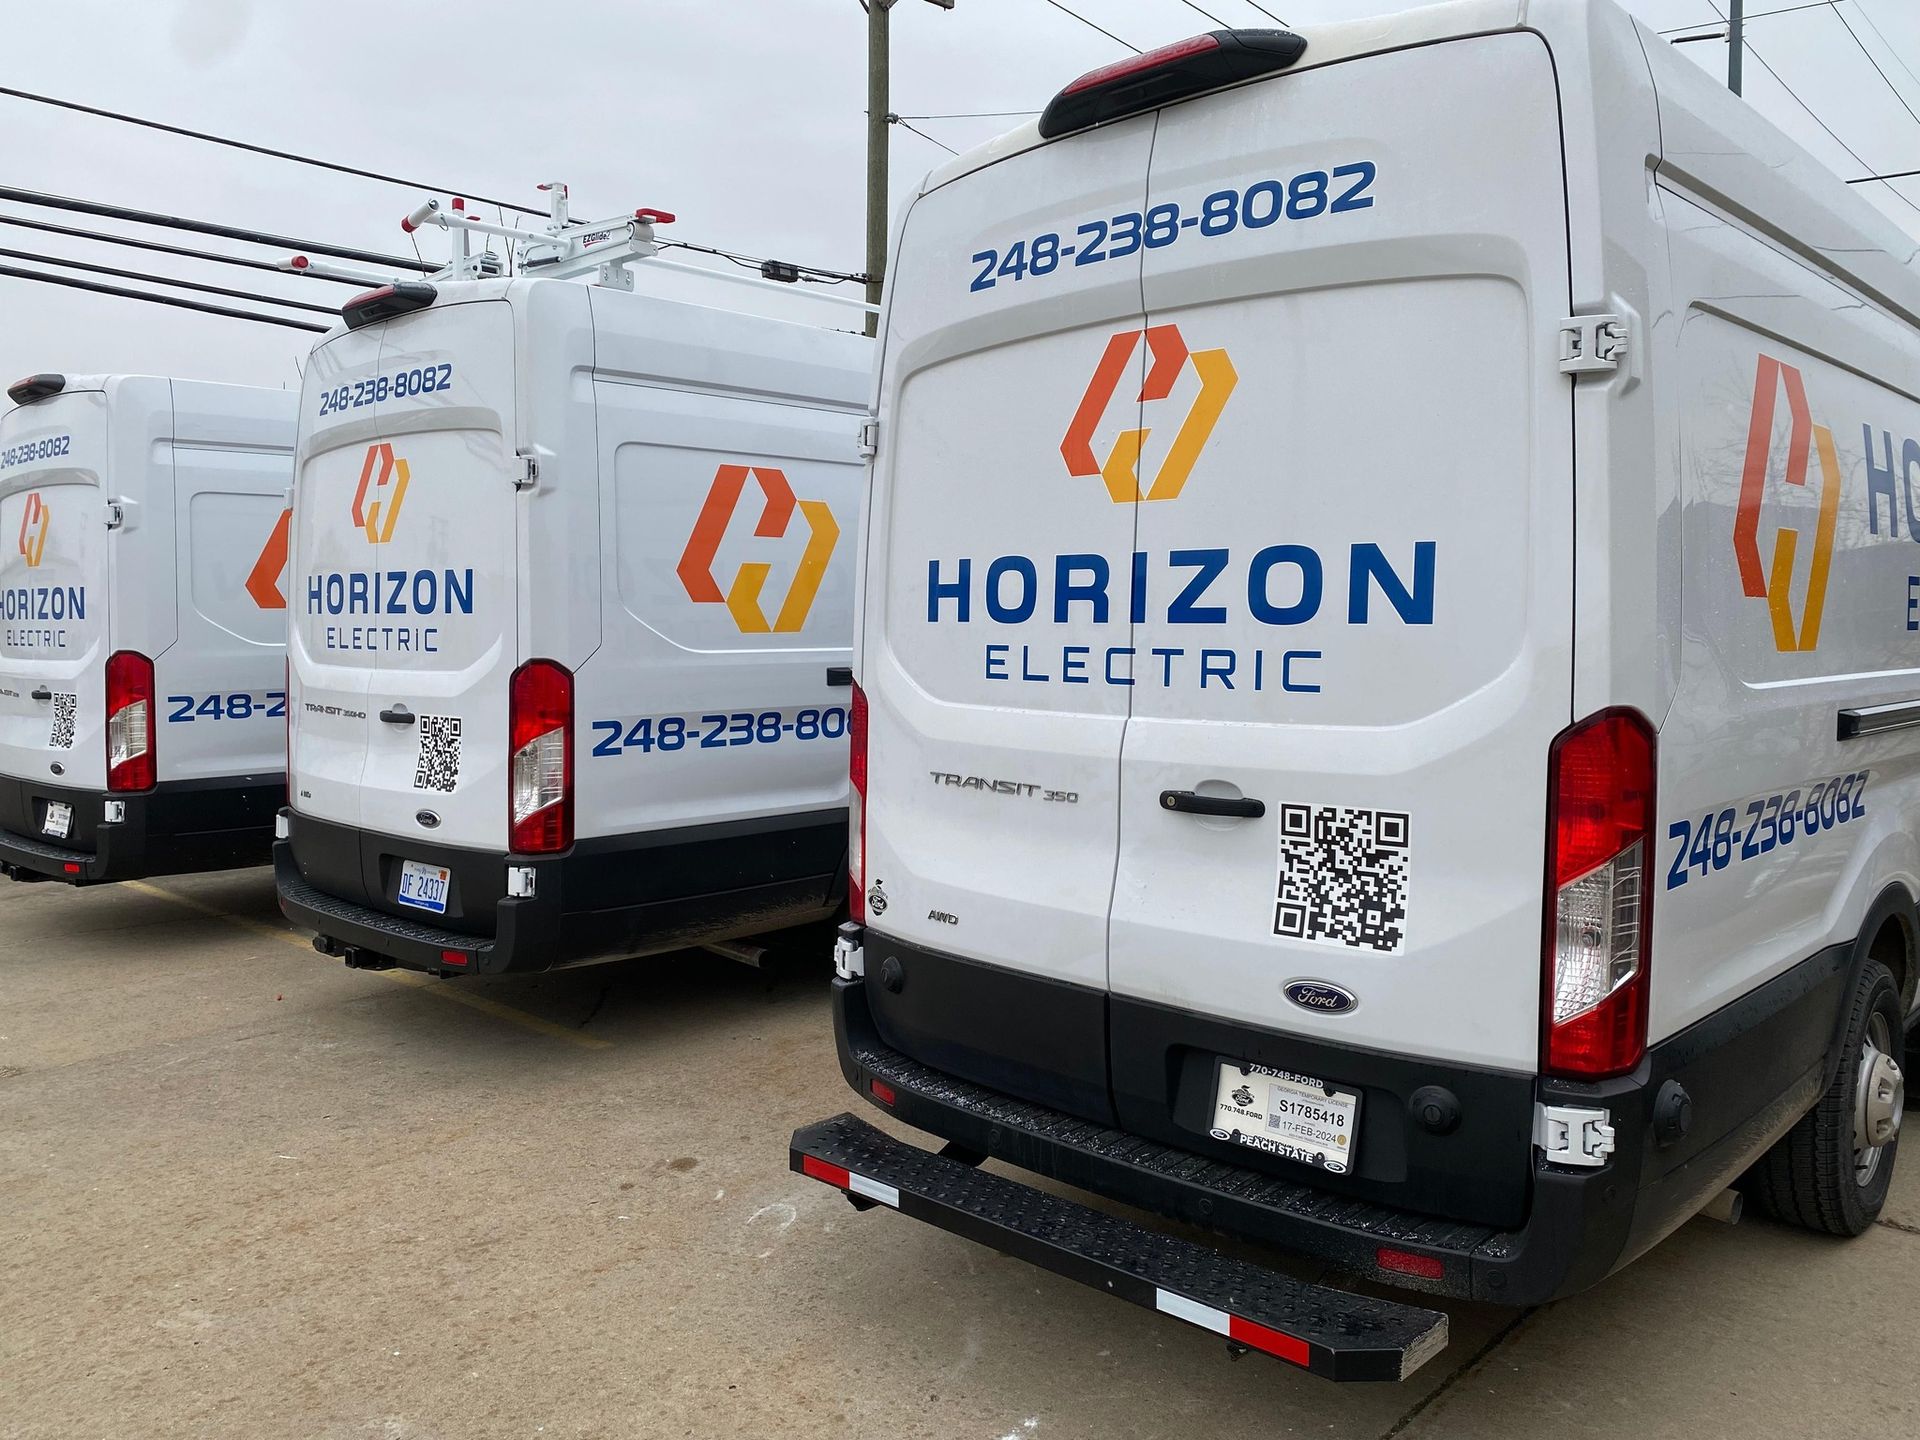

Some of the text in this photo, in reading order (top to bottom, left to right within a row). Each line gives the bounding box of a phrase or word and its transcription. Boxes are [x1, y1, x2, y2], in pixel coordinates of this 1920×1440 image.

[969, 161, 1376, 293] 248-238-8082
[319, 363, 452, 416] 248-238-8082
[307, 568, 473, 615] HORIZON
[927, 541, 1436, 625] HORIZON
[7, 629, 66, 648] ELECTRIC
[327, 627, 438, 652] ELECTRIC
[985, 644, 1322, 693] ELECTRIC
[591, 707, 853, 757] 248-238-80
[930, 771, 1079, 803] TRANSIT 350
[1667, 769, 1870, 890] 248-238-8082
[402, 873, 445, 901] DF 24337
[928, 910, 958, 925] AWD
[1297, 986, 1338, 1008] Ford
[1249, 1063, 1324, 1088] 770-748-FORD
[1220, 1103, 1263, 1120] 770.748.FORD
[1279, 1099, 1345, 1127] S1785418
[1283, 1121, 1337, 1143] 17-FEB-2024
[1239, 1134, 1276, 1153] PEACH
[1277, 1144, 1314, 1163] STATE
